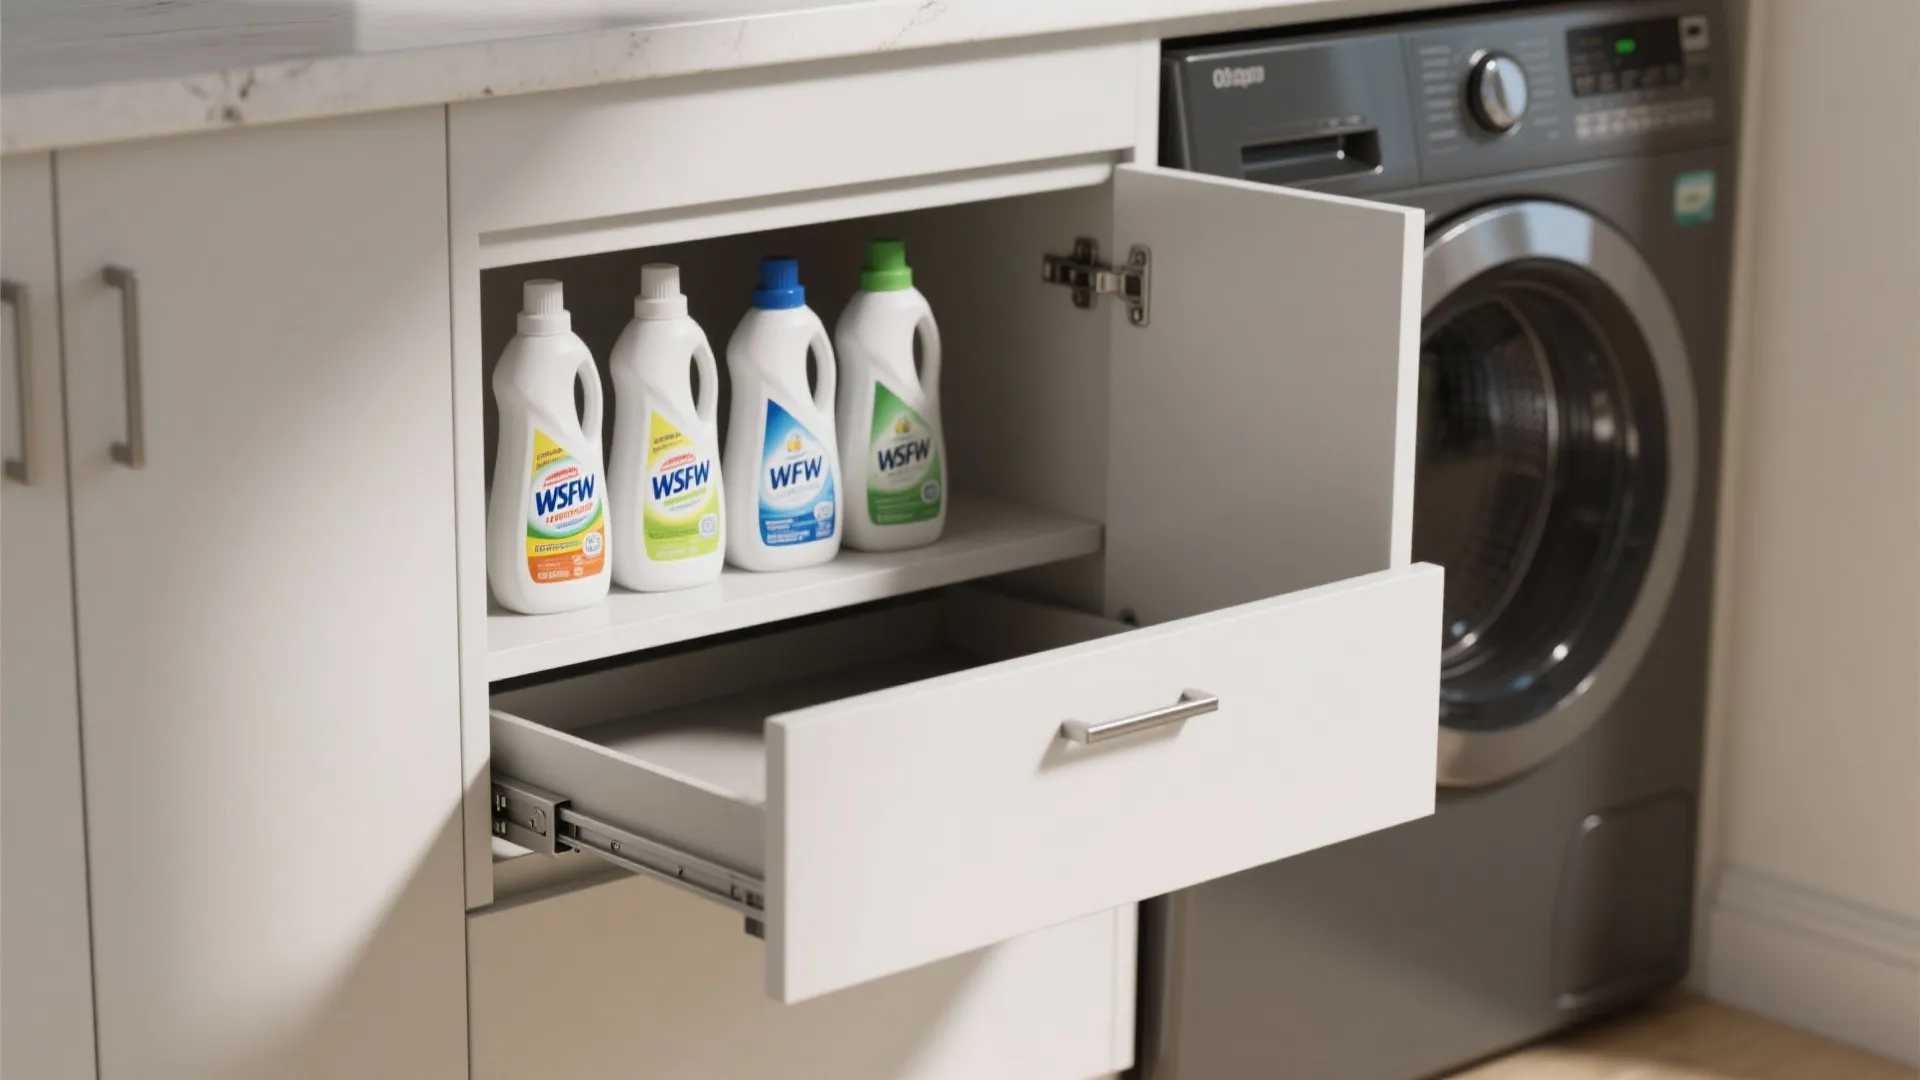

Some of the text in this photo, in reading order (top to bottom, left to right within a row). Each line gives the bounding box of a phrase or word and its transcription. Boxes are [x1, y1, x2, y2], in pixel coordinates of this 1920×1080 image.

[770, 455, 822, 490] WFW
[878, 437, 931, 472] WSFW
[535, 473, 595, 517] WSFW
[652, 459, 710, 500] WSFW
